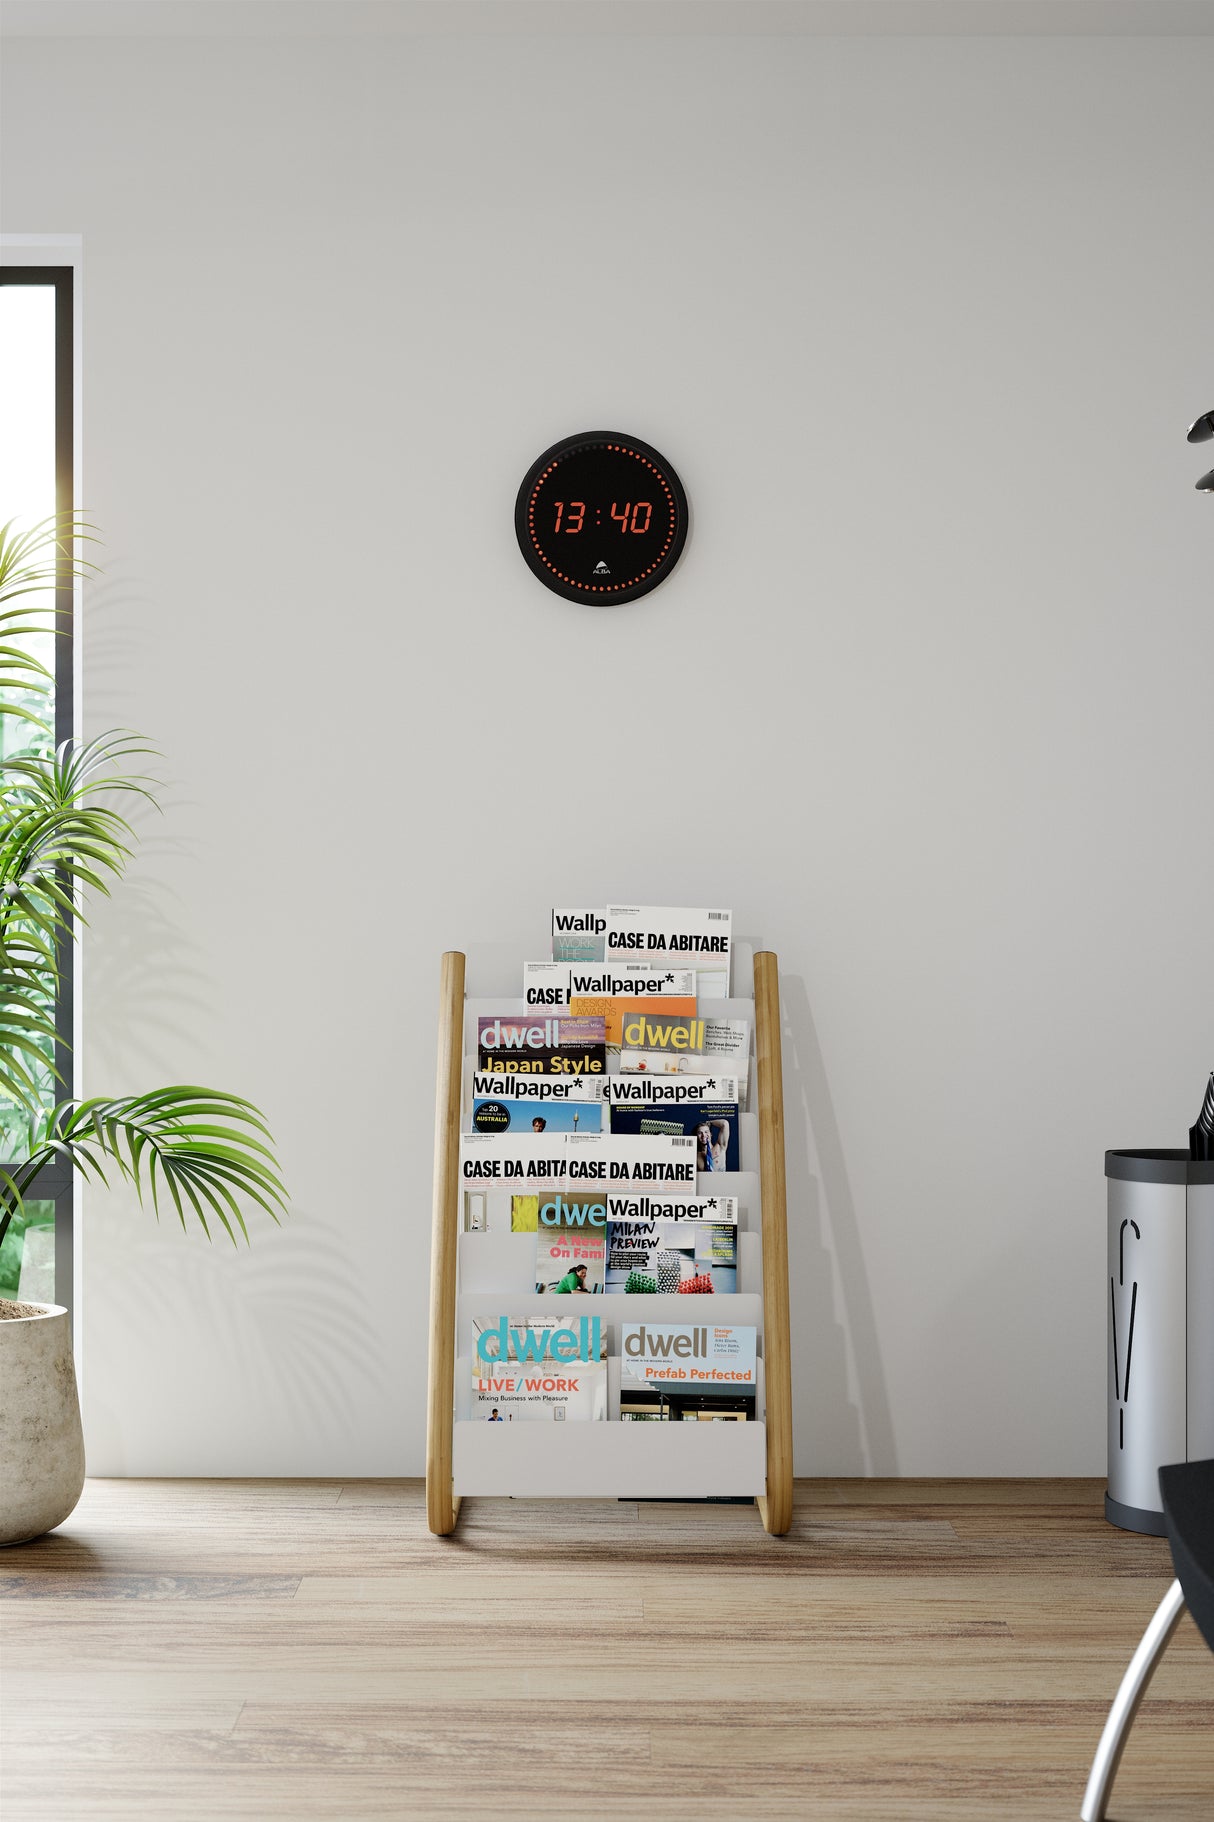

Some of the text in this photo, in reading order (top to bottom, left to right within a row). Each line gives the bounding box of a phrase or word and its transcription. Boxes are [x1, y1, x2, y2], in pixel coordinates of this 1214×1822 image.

[556, 914, 606, 934] Wallp
[559, 937, 595, 948] WORK
[608, 932, 728, 953] CASE DA ABITARE
[527, 988, 563, 1005] CASE
[576, 999, 612, 1007] DESIGN
[576, 1007, 617, 1016] AWARDS
[480, 1020, 559, 1049] dwell
[625, 1017, 704, 1049] dwell
[482, 1055, 602, 1076] Japan Style
[463, 1160, 501, 1178] CASE
[504, 1160, 524, 1177] DA
[569, 1160, 694, 1181] CASE DA ABITARE
[611, 1222, 656, 1236] MILAN
[557, 1235, 603, 1246] A New
[610, 1237, 660, 1250] PREVIEW
[550, 1247, 570, 1258] On
[477, 1316, 600, 1363] dwell
[625, 1326, 707, 1358] dwell
[645, 1367, 752, 1381] Prefab Perfected
[478, 1378, 580, 1392] LIVE/WORK
